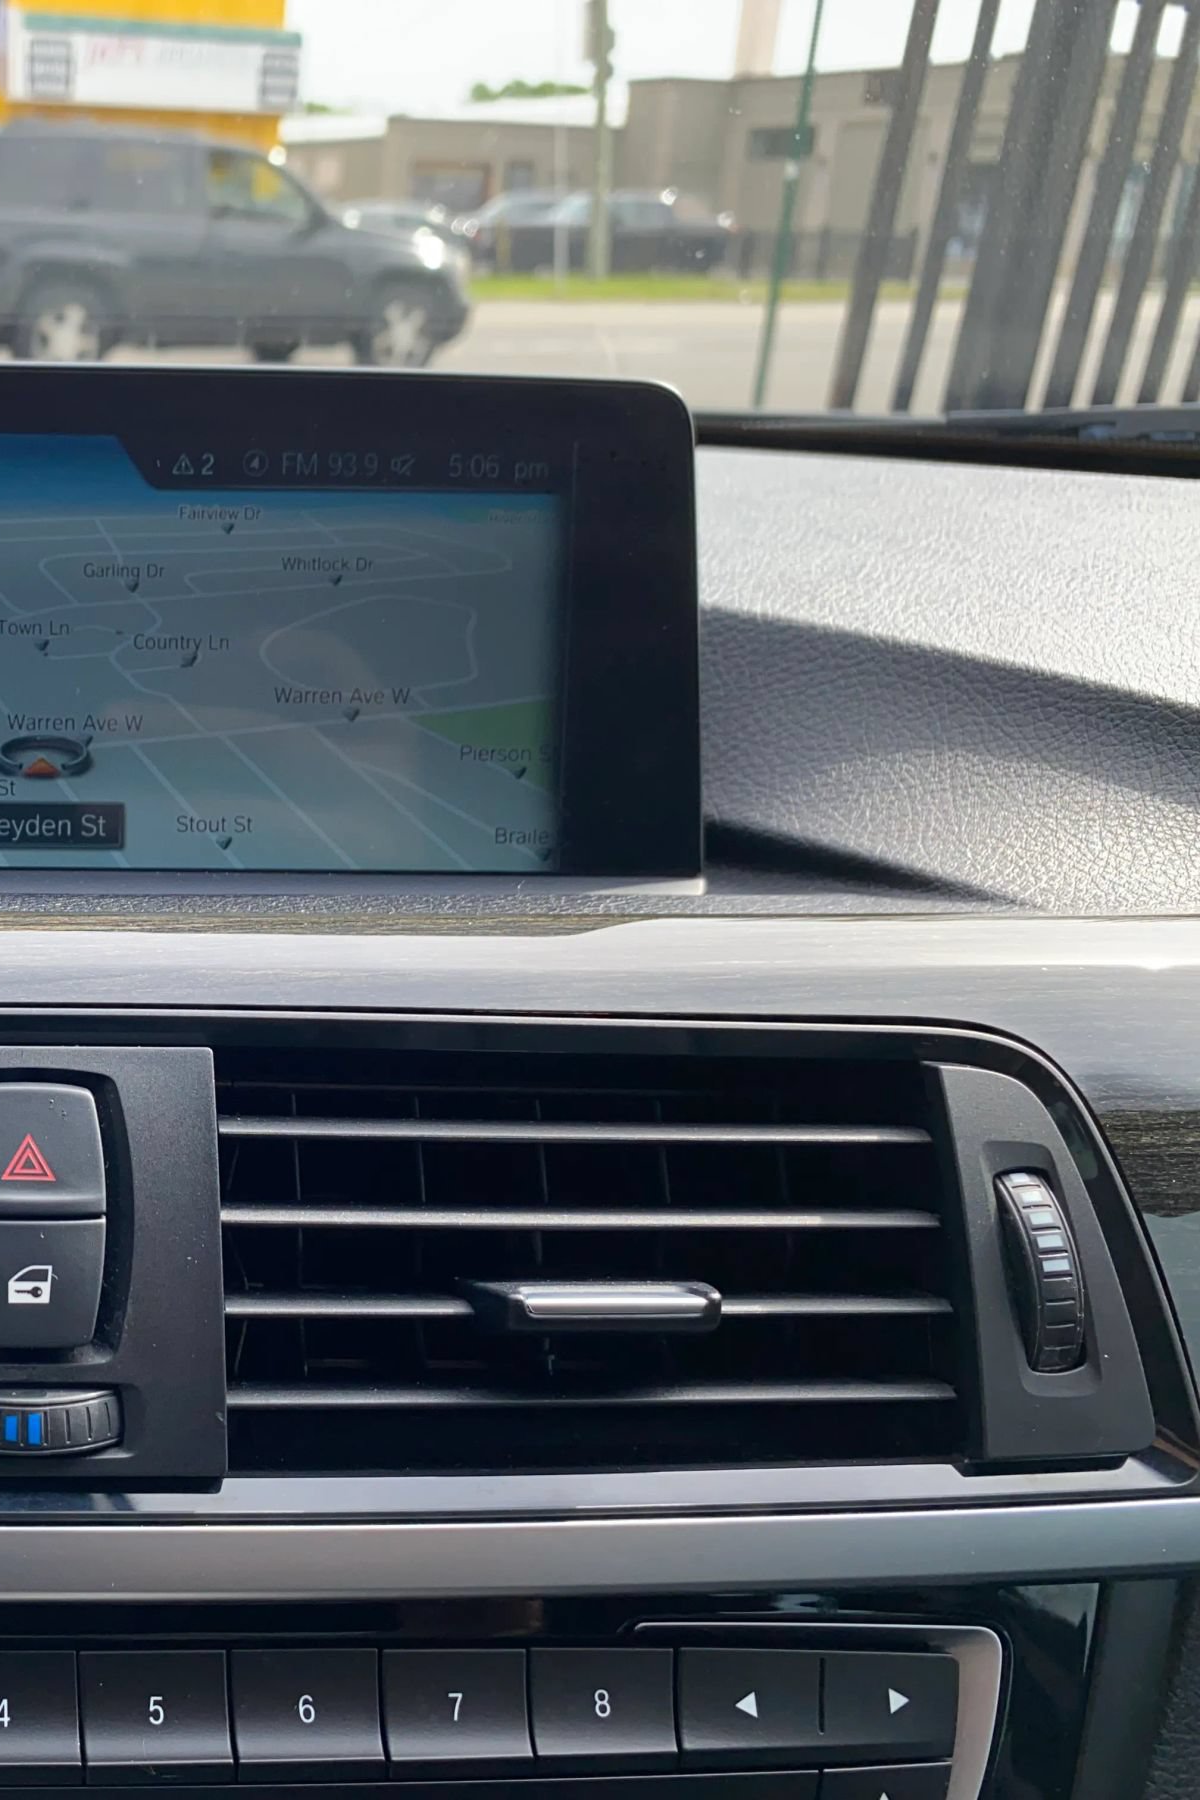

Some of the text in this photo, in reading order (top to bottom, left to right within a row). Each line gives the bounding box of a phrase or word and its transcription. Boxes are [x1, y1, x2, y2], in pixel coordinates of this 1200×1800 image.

[201, 453, 215, 475] 2
[282, 452, 379, 477] FM 93.9
[449, 454, 549, 484] 5:06 pm
[178, 505, 261, 521] Fairview Dr
[83, 563, 164, 580] Garling Dr
[281, 557, 373, 573] Whitlock Dr
[49, 620, 70, 636] Ln
[133, 634, 230, 654] Country Ln
[275, 687, 410, 704] Warren Ave W
[7, 714, 143, 732] Warren Ave W
[460, 744, 532, 762] Pierson
[81, 814, 106, 837] St
[176, 815, 252, 833] Stout St
[148, 1697, 164, 1725] 5
[298, 1695, 315, 1723] 6
[448, 1692, 463, 1721] 7
[594, 1690, 611, 1718] 8
